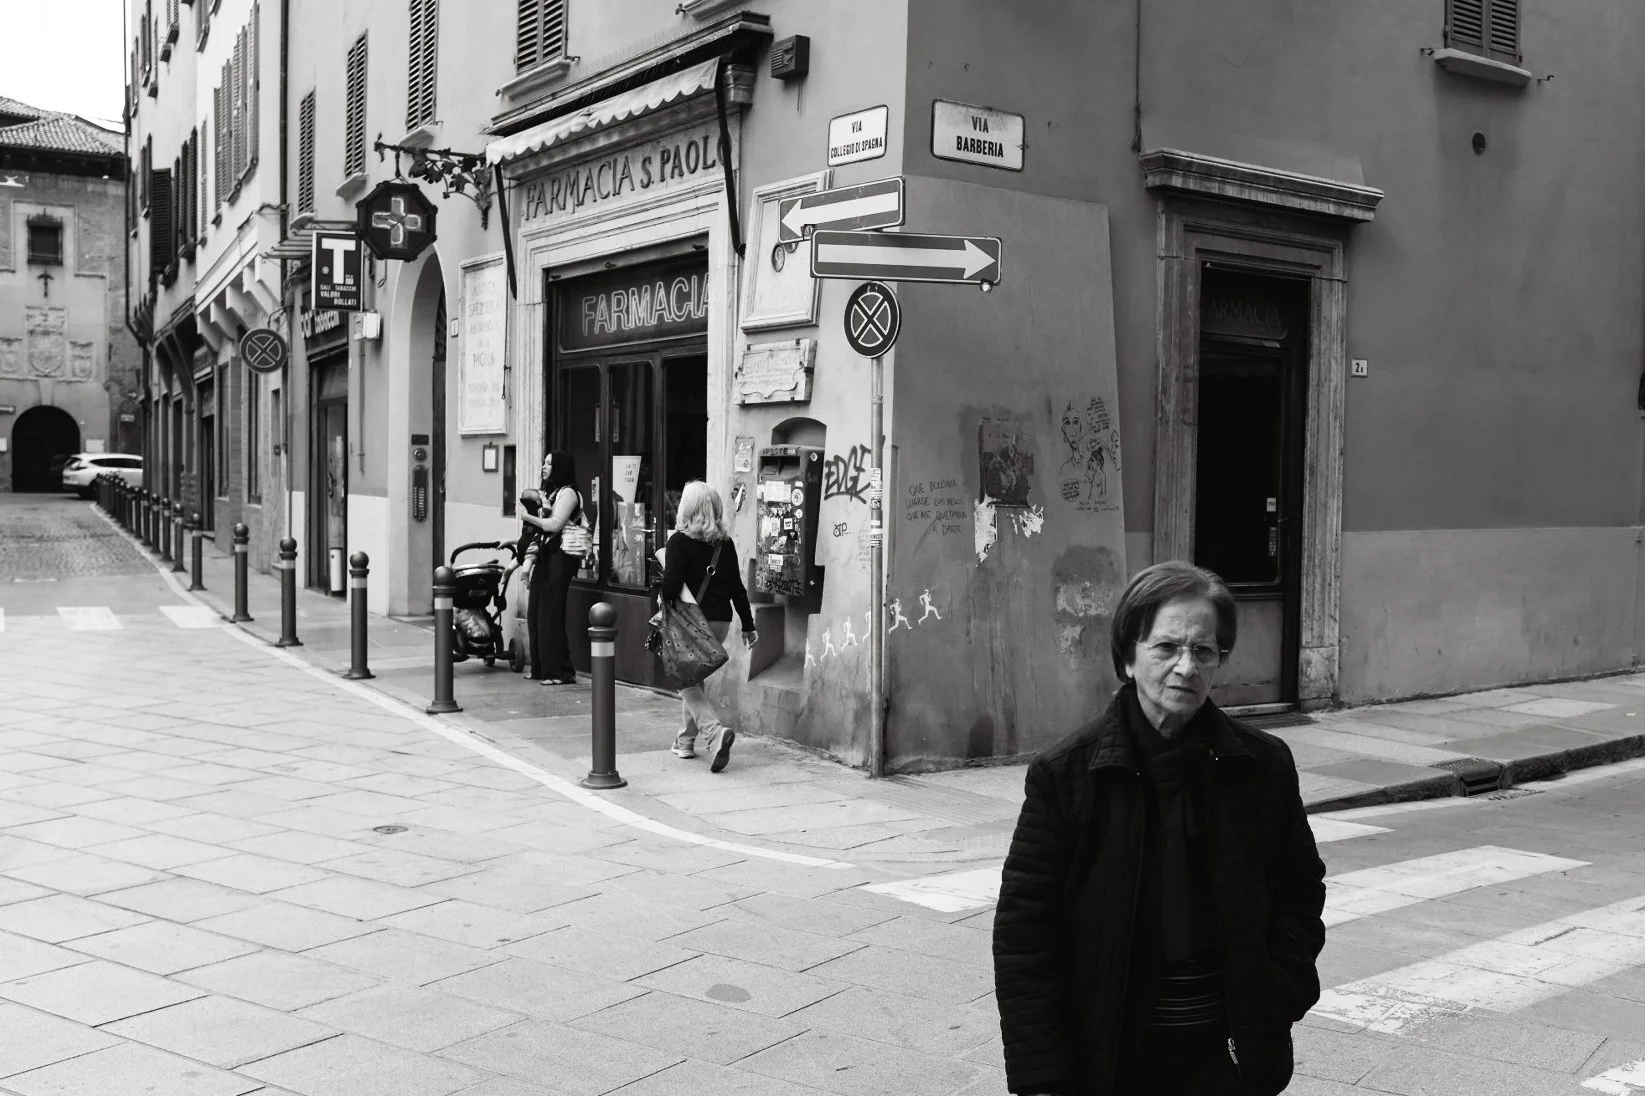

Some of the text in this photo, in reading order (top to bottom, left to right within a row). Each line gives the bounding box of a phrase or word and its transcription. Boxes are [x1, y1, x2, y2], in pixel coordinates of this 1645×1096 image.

[851, 120, 863, 134] VIA
[971, 115, 989, 134] VIA
[830, 136, 883, 159] COLLEGIO DI SPAGNA
[956, 135, 1004, 158] BARBERIA
[524, 155, 636, 221] FARMACIA
[321, 237, 357, 285] T
[320, 290, 341, 298] VALORI
[333, 297, 357, 306] BOLLATI
[1207, 296, 1282, 330] ARMACIA
